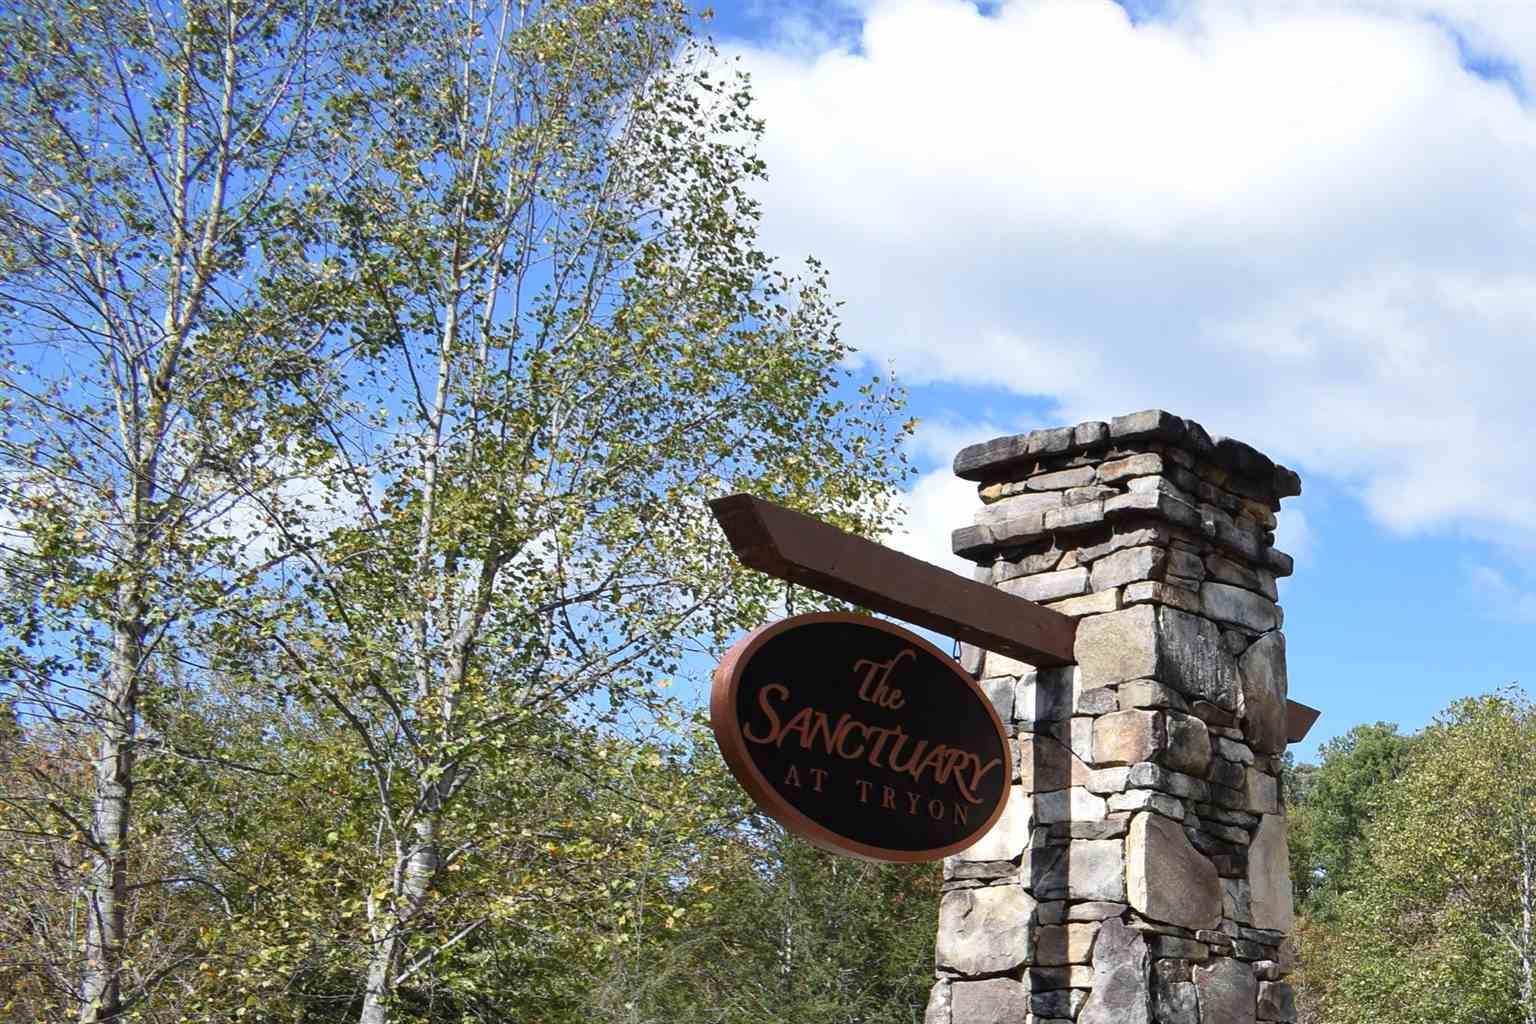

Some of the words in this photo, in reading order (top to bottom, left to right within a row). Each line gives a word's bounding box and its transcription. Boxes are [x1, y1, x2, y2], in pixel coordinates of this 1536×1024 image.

[854, 650, 916, 710] The
[743, 683, 1002, 804] SANCTUARY
[784, 764, 829, 793] AT
[856, 779, 969, 826] TRYON
